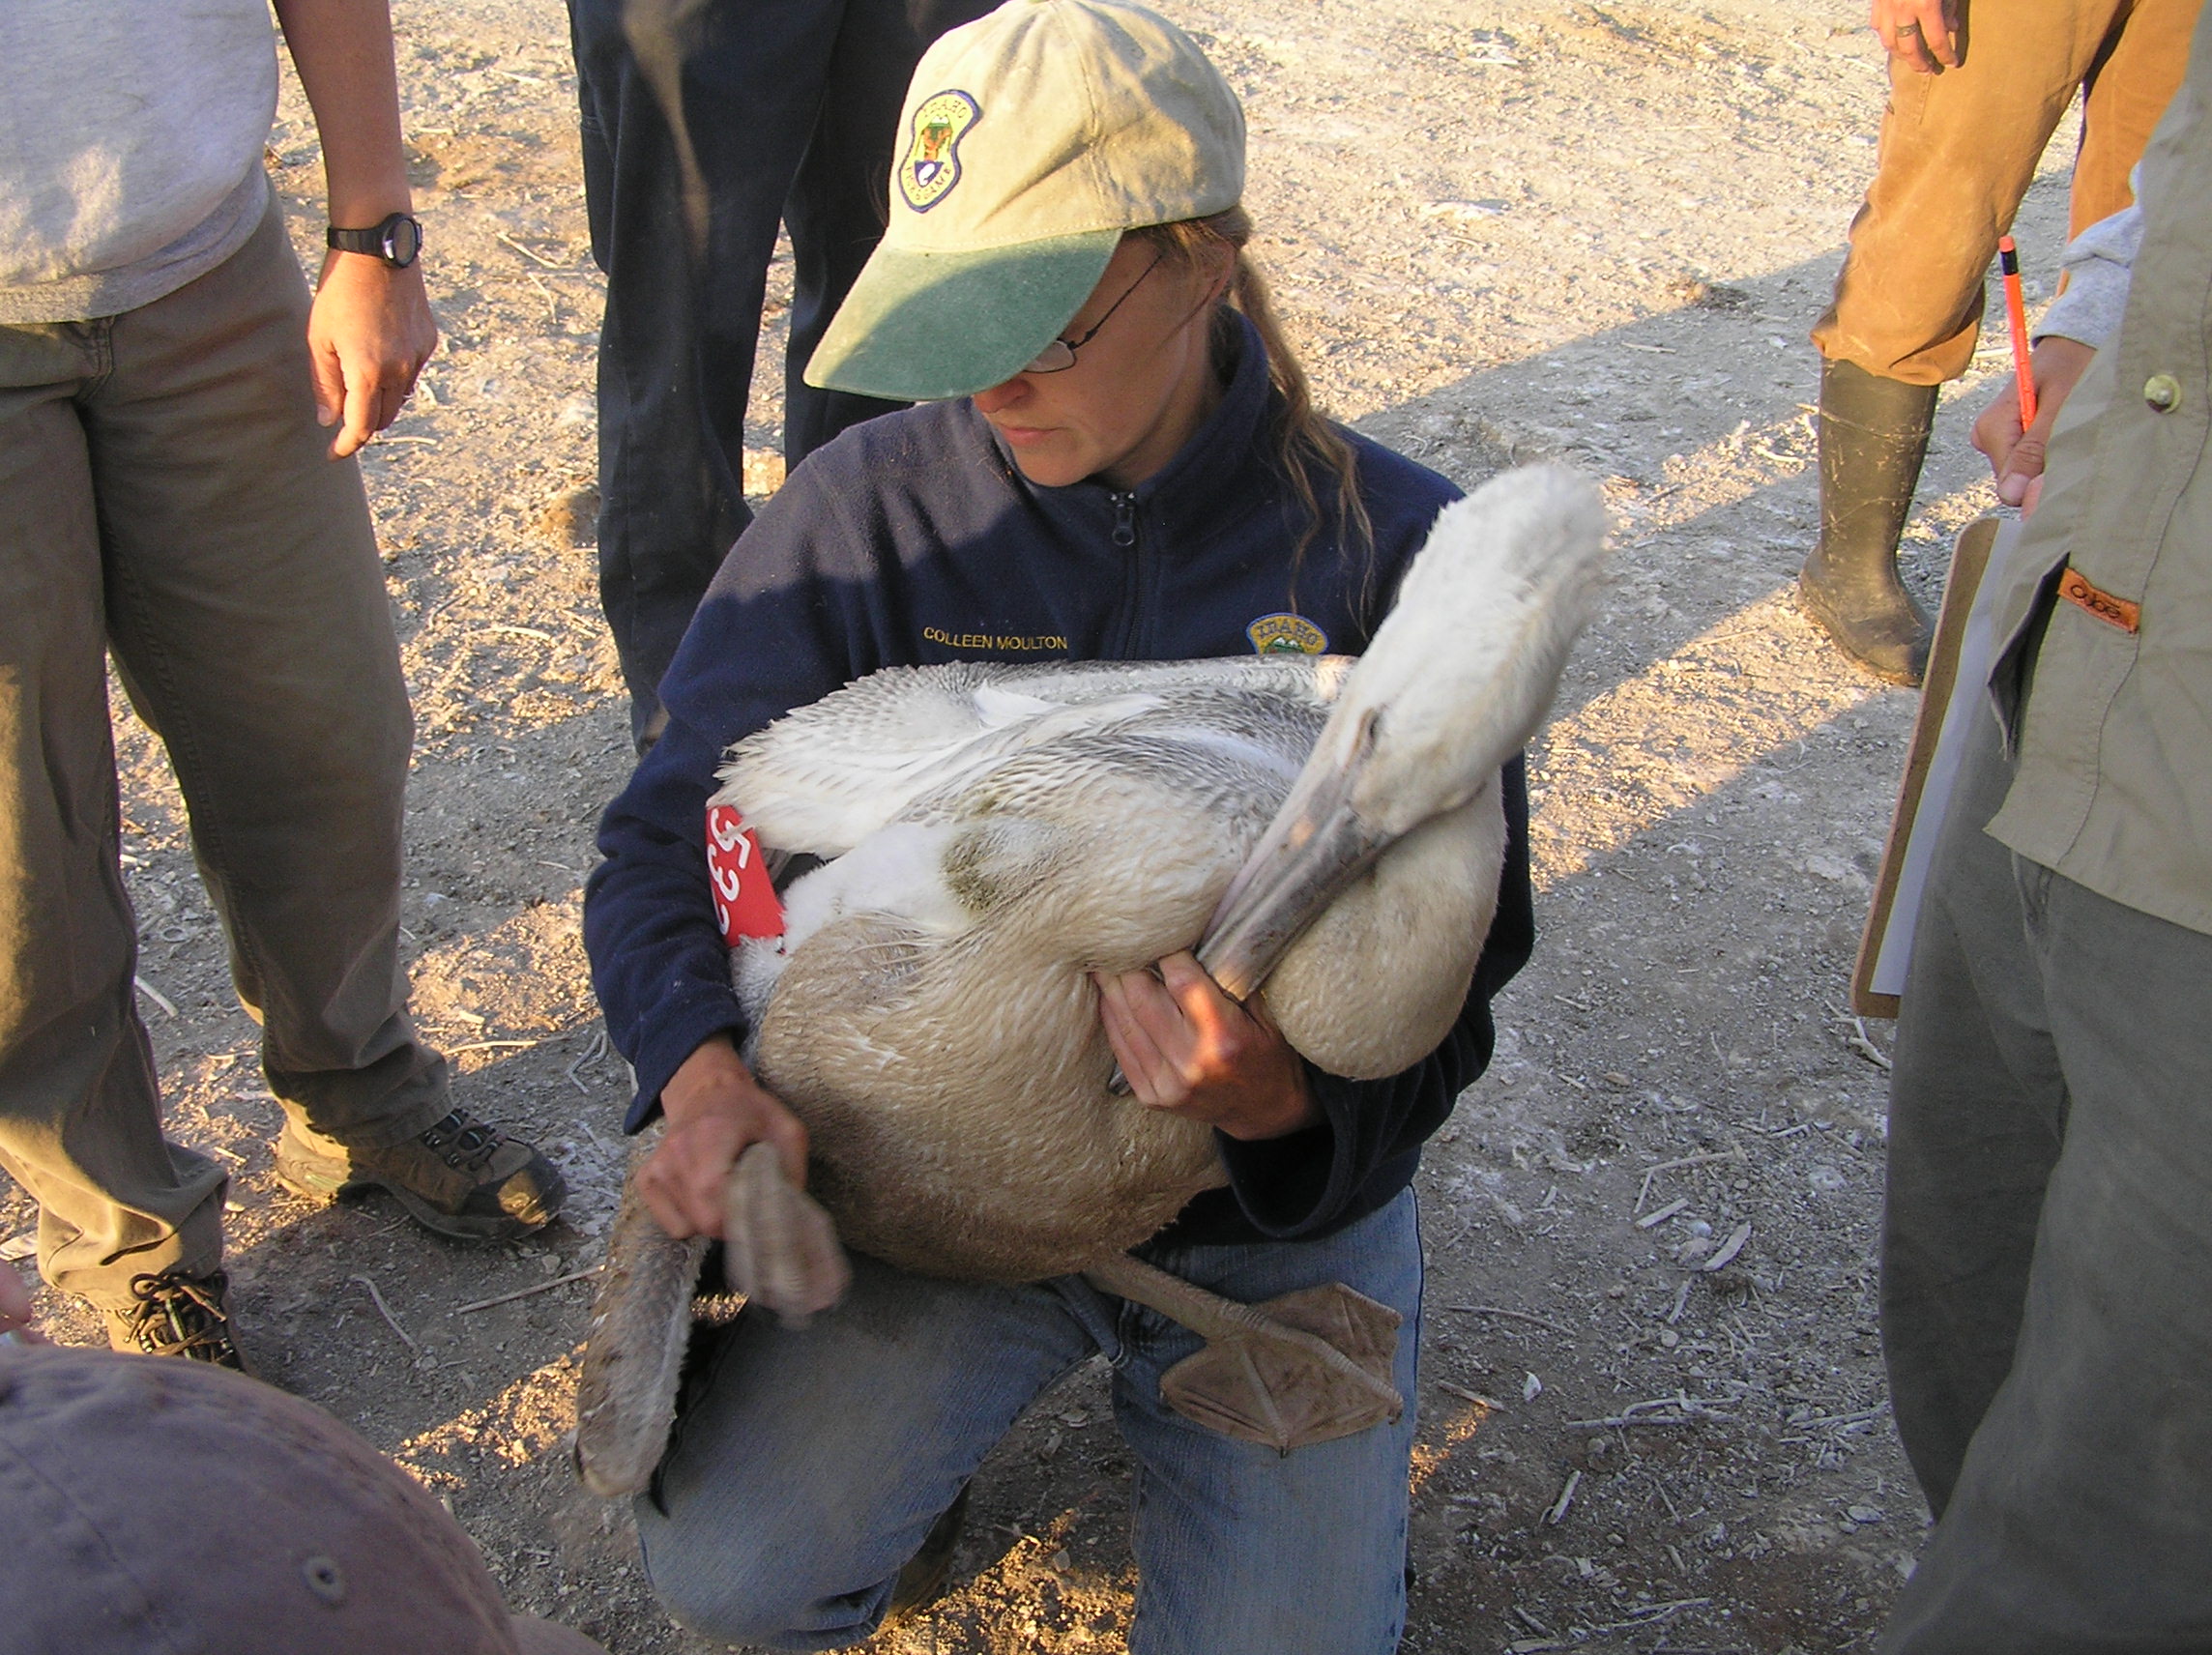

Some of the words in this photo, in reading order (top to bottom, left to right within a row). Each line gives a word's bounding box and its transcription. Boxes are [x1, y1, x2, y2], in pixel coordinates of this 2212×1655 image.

[922, 99, 968, 119] IDAHO
[922, 625, 993, 650] COLLEEN
[997, 635, 1068, 651] MOULTON
[1258, 619, 1318, 646] IDAHO
